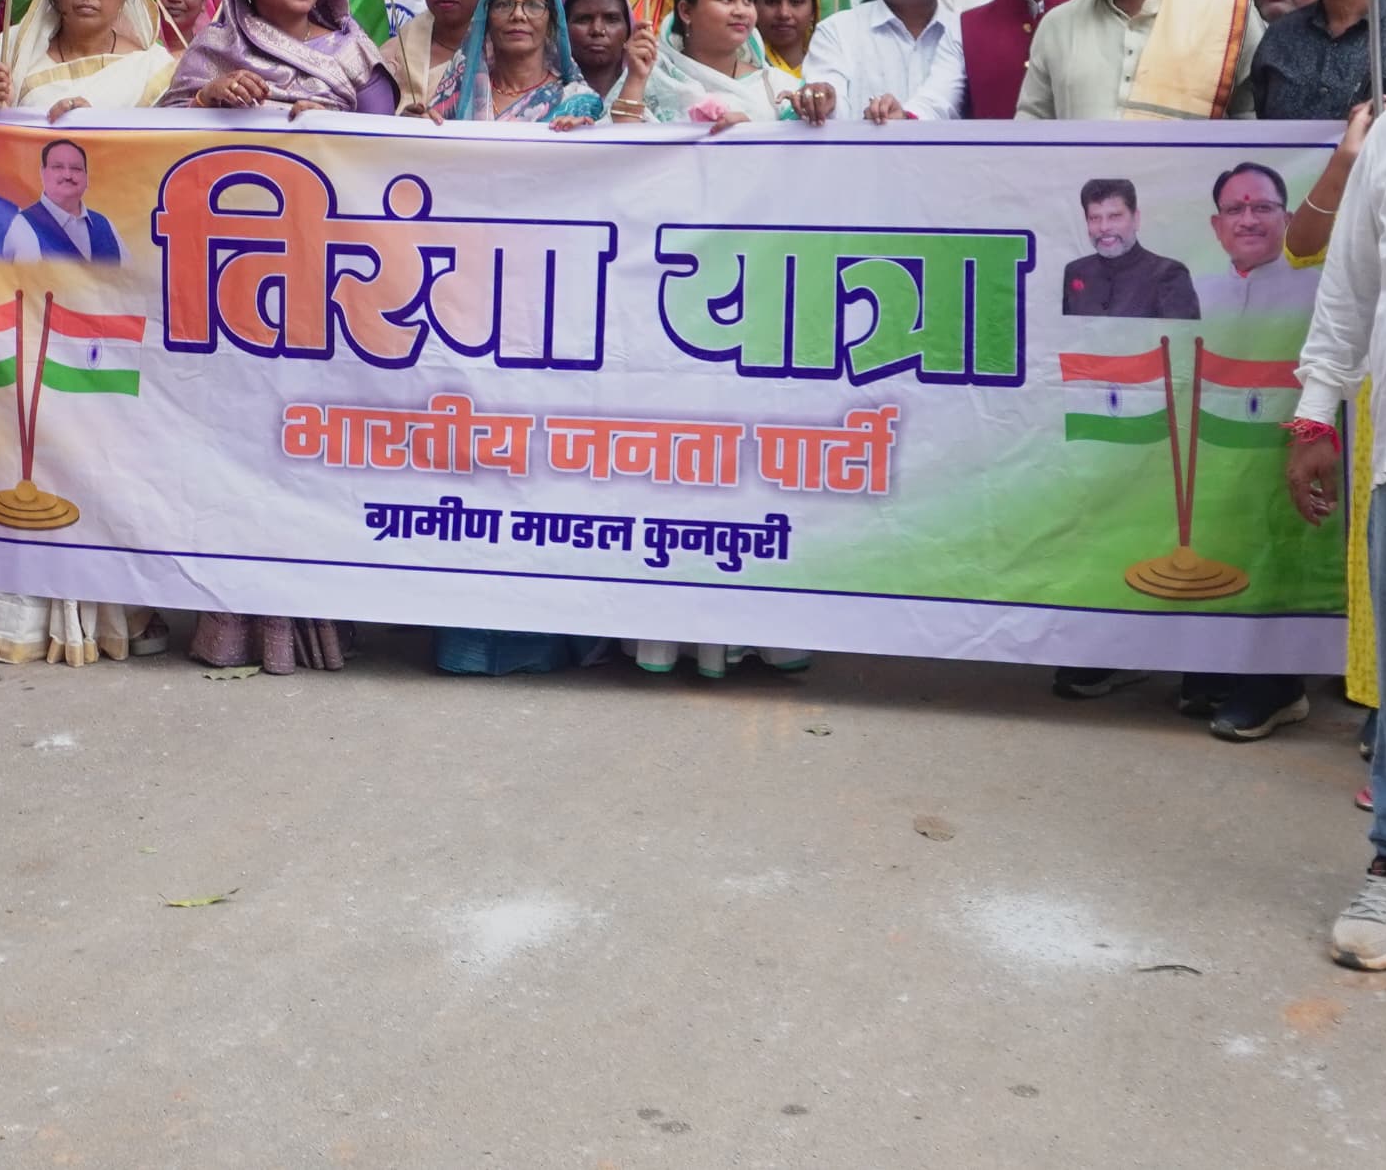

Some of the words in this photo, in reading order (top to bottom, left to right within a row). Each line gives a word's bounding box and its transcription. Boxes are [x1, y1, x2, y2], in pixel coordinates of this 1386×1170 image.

[151, 144, 618, 370] तिरंगा
[655, 224, 1036, 386] यात्रा
[281, 394, 534, 478] भारतीय
[544, 415, 743, 486] जनता
[755, 404, 901, 494] पार्टी
[365, 497, 502, 543] ग्रामीण
[511, 511, 635, 551] मण्डल
[644, 513, 792, 572] कुनकुरी
